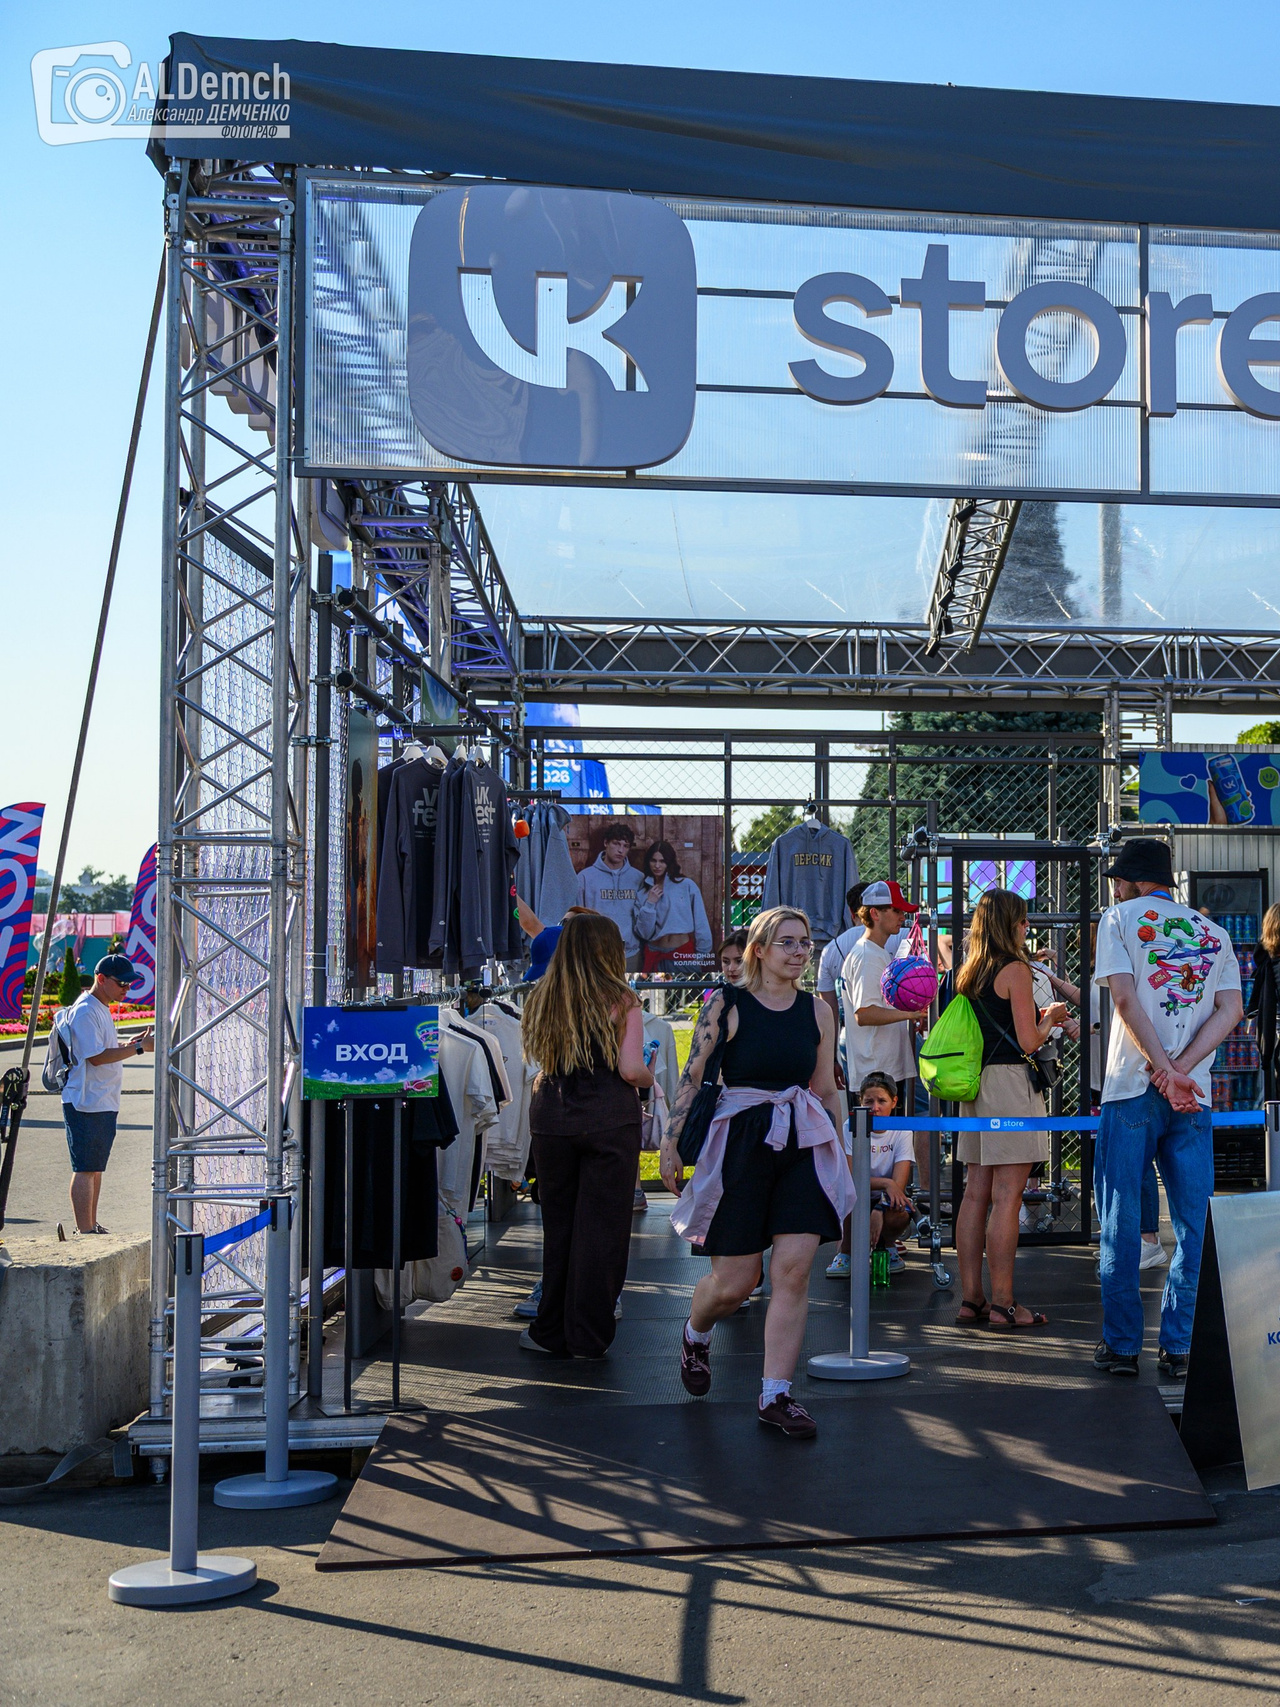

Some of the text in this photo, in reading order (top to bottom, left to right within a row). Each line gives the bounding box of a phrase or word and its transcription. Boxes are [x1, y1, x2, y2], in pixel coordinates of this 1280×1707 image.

[457, 266, 650, 393] VK
[794, 853, 833, 867] ПЕРСИК
[673, 952, 715, 961] Стикерная
[674, 959, 715, 967] коллекция
[336, 1043, 408, 1064] ВХОД
